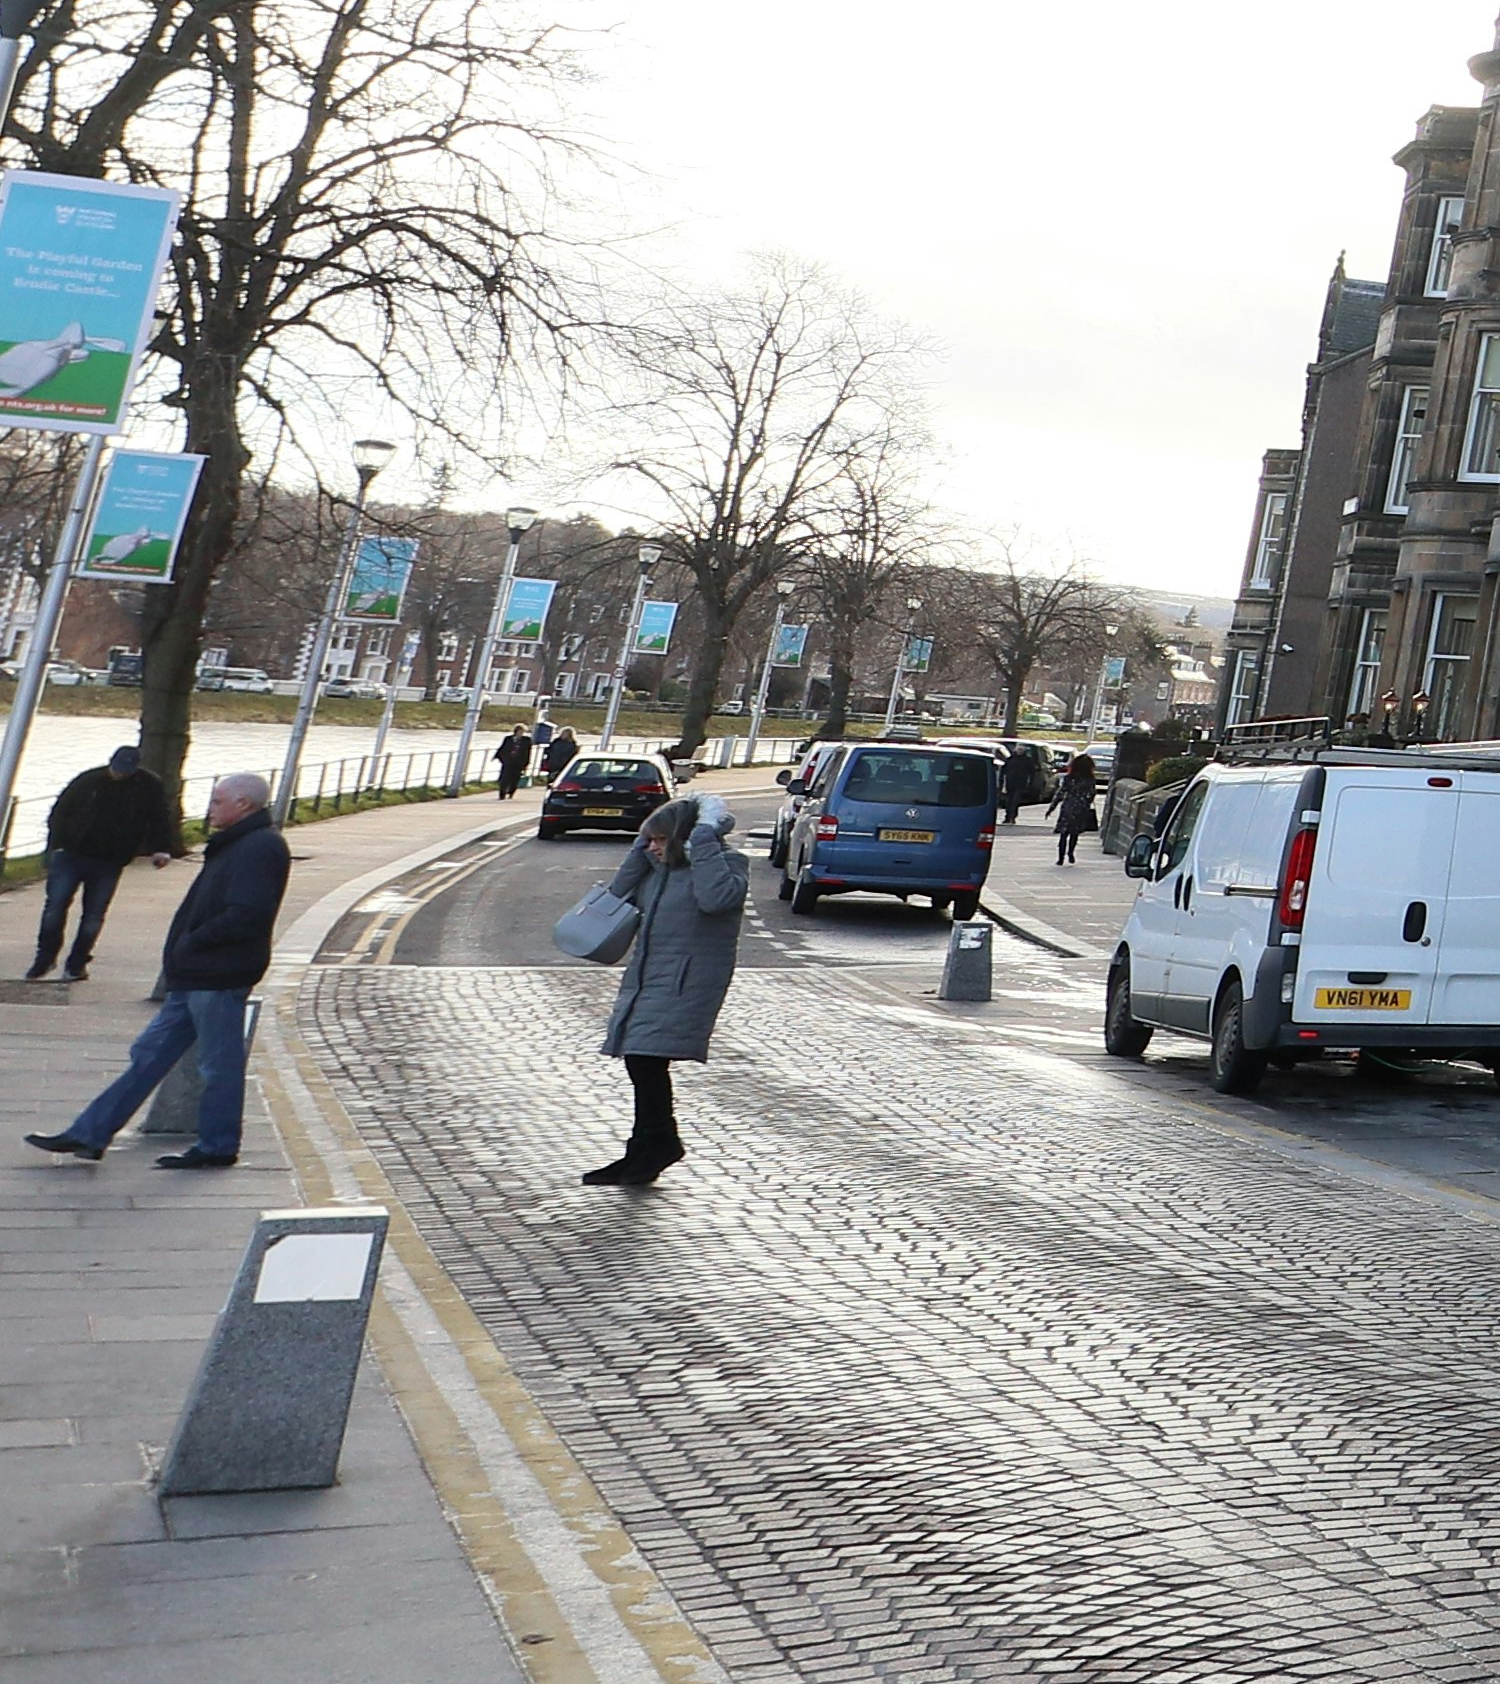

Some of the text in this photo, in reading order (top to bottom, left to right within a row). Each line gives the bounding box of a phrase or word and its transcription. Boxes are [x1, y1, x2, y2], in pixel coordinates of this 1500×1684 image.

[5, 247, 143, 272] The Playful Garden
[1326, 990, 1399, 1006] VN61 YMA
